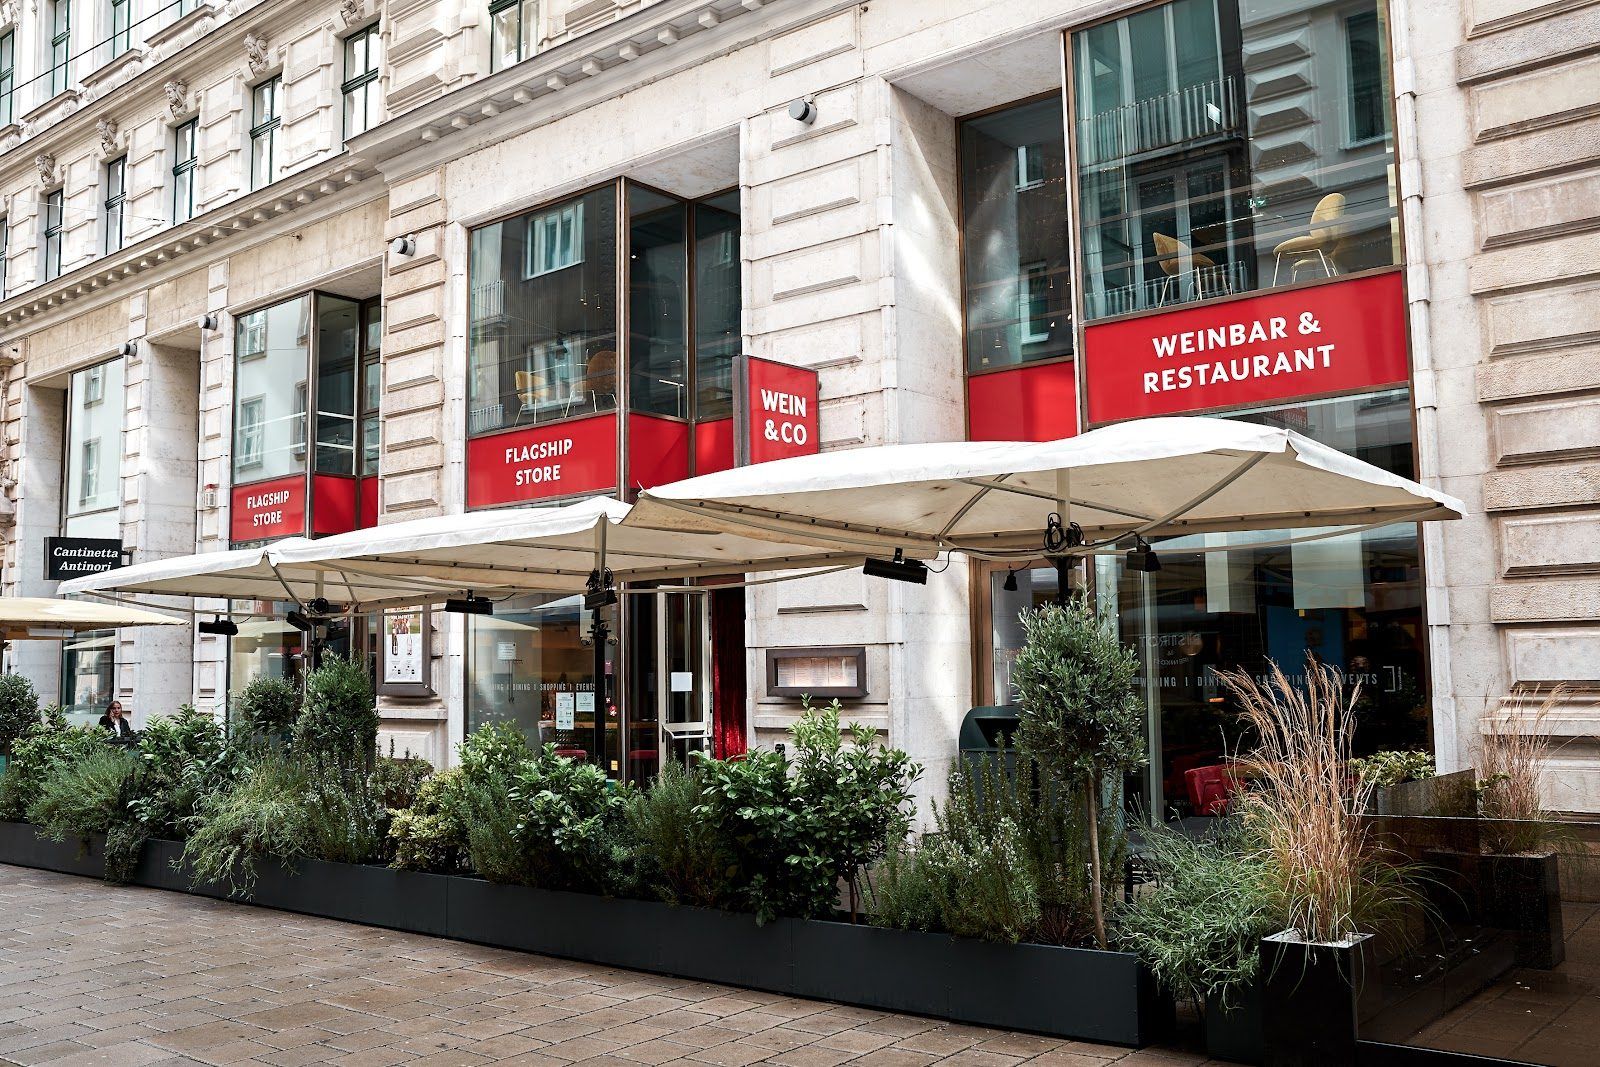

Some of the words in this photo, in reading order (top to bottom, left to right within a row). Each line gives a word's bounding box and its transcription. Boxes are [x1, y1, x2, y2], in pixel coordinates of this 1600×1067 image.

[1152, 316, 1287, 358] WEINBAR
[1298, 311, 1322, 336] &
[1143, 344, 1335, 394] RESTAURANT
[761, 388, 807, 418] WEIN
[505, 438, 573, 464] FLAGSHIP
[515, 465, 561, 487] STORE
[247, 490, 290, 509] FLAGSHIP
[253, 511, 282, 527] STORE
[53, 547, 119, 558] Cantinetta
[59, 561, 112, 572] Antinori
[540, 683, 566, 691] SHOPPING
